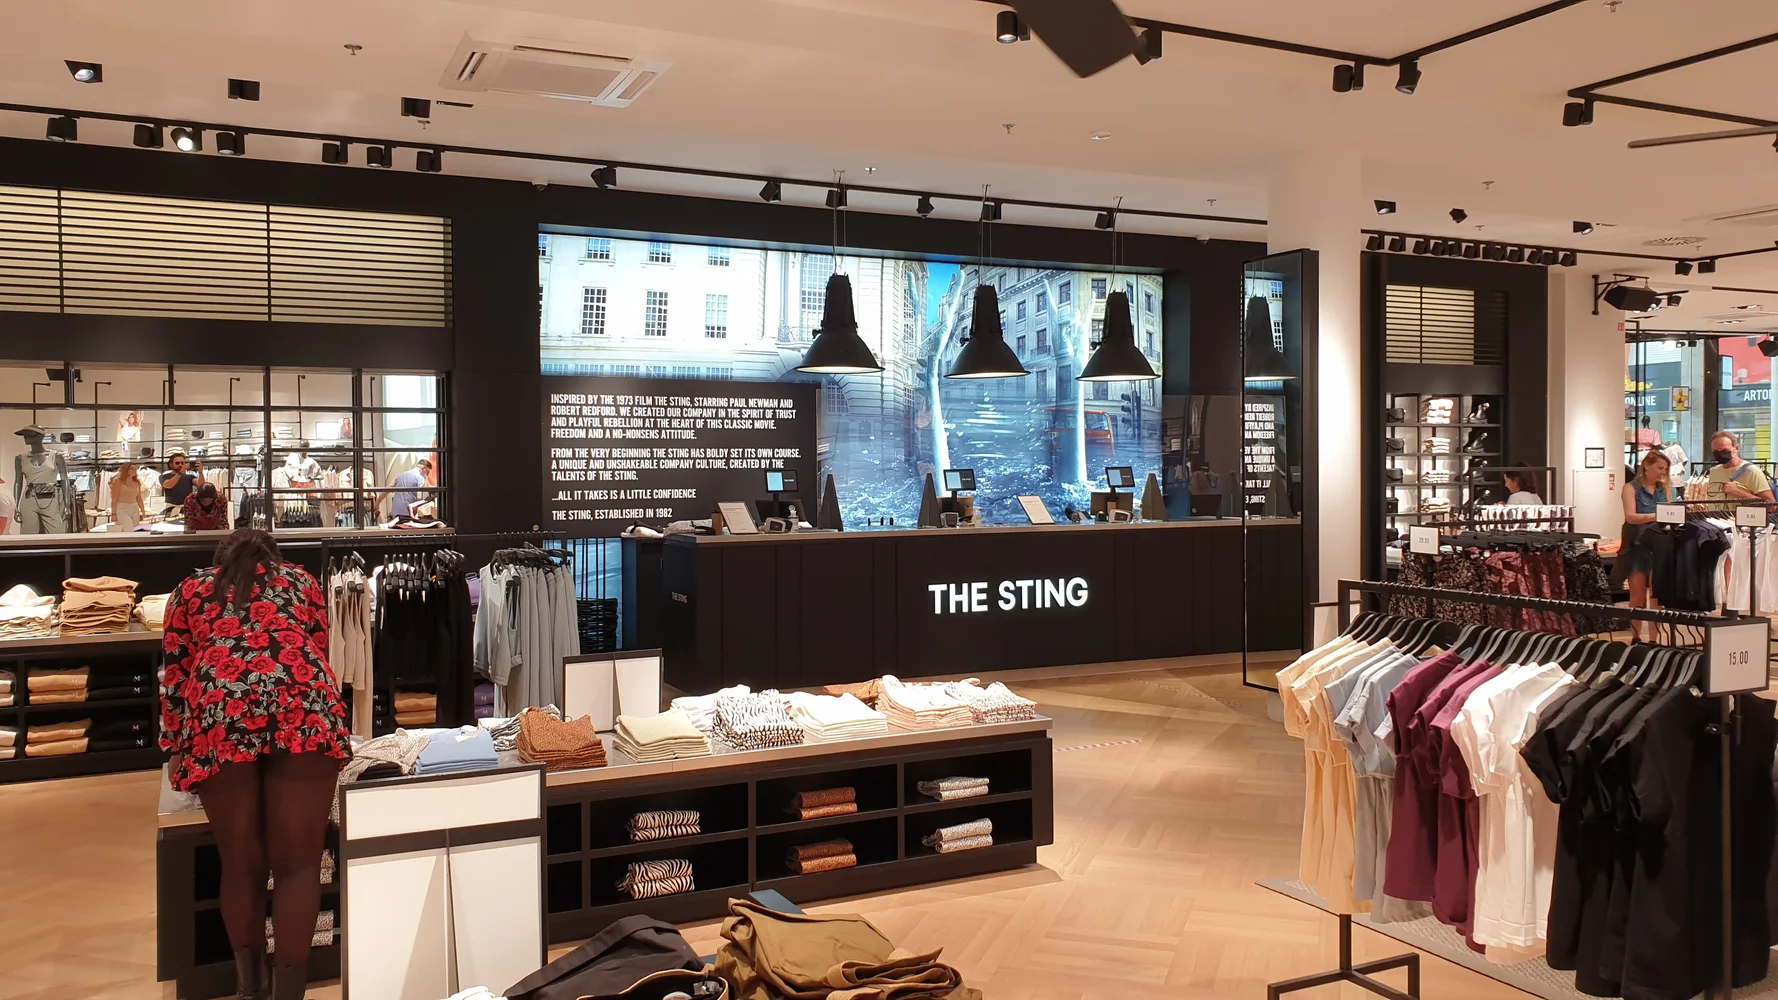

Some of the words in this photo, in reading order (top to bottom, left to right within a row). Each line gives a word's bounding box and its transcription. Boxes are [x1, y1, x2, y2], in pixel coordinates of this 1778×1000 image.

[551, 394, 586, 404] INSPIRED
[588, 395, 599, 405] BY
[600, 395, 615, 405] THE
[616, 395, 634, 405] 1973
[635, 396, 653, 406] FILM
[654, 396, 668, 406] THE
[669, 397, 692, 407] STING,
[694, 397, 728, 407] STARRING
[729, 398, 747, 407] PAUL
[748, 398, 778, 408] NEWMAN
[780, 399, 793, 408] AND
[551, 406, 580, 415] ROBERT
[582, 406, 618, 416] REDFORD.
[620, 407, 631, 416] WE
[633, 407, 665, 417] CREATED
[667, 408, 681, 417] OUR
[683, 408, 717, 417] COMPANY
[718, 409, 726, 418] IN
[727, 409, 740, 418] THE
[741, 409, 764, 418] SPIRIT
[765, 409, 774, 418] OF
[775, 410, 796, 419] TRUST
[551, 417, 567, 426] AND
[568, 417, 602, 427] PLAYFUL
[603, 418, 643, 427] REBELLION
[645, 418, 655, 427] AT
[656, 418, 670, 428] THE
[671, 419, 695, 428] HEART
[696, 419, 705, 428] OF
[706, 419, 723, 428] THIS
[724, 420, 753, 428] CLASSIC
[754, 420, 777, 429] MOVIE.
[551, 429, 586, 438] FREEDOM
[588, 429, 604, 439] AND
[605, 429, 611, 439] A
[612, 429, 660, 439] NO-NONSENS
[661, 430, 697, 439] ATTITUDE.
[551, 448, 573, 458] FROM
[574, 448, 589, 458] THE
[590, 448, 610, 458] VERY
[612, 448, 651, 458] BEGINNING
[652, 448, 666, 458] THE
[668, 448, 689, 458] STING
[690, 448, 705, 458] HAS
[706, 448, 728, 458] BOLDY
[730, 449, 743, 457] SET
[744, 449, 755, 457] ITS
[757, 449, 772, 457] OWN
[774, 449, 801, 457] COURSE.
[551, 460, 557, 469] A
[560, 460, 587, 469] UNIQUE
[589, 460, 604, 469] AND
[606, 460, 658, 469] UNSHAKEABLE
[660, 459, 694, 469] COMPANY
[695, 459, 728, 470] CULTURE,
[729, 459, 759, 468] CREATED
[761, 459, 770, 468] BY
[771, 459, 784, 468] THE
[551, 471, 586, 480] TALENTS
[587, 471, 597, 480] OF
[599, 471, 613, 480] THE
[614, 471, 639, 480] STING.
[552, 490, 572, 500] ...ALL
[574, 490, 582, 500] IT
[584, 490, 608, 500] TAKES
[610, 490, 618, 499] IS
[620, 490, 626, 499] A
[627, 489, 652, 499] LITTLE
[653, 489, 697, 499] CONFIDENCE
[552, 510, 566, 520] THE
[568, 510, 593, 521] STING,
[595, 509, 644, 519] ESTABLISHED
[645, 508, 654, 518] IN
[655, 508, 673, 517] 1982
[928, 582, 988, 614] THE
[998, 577, 1088, 611] STING
